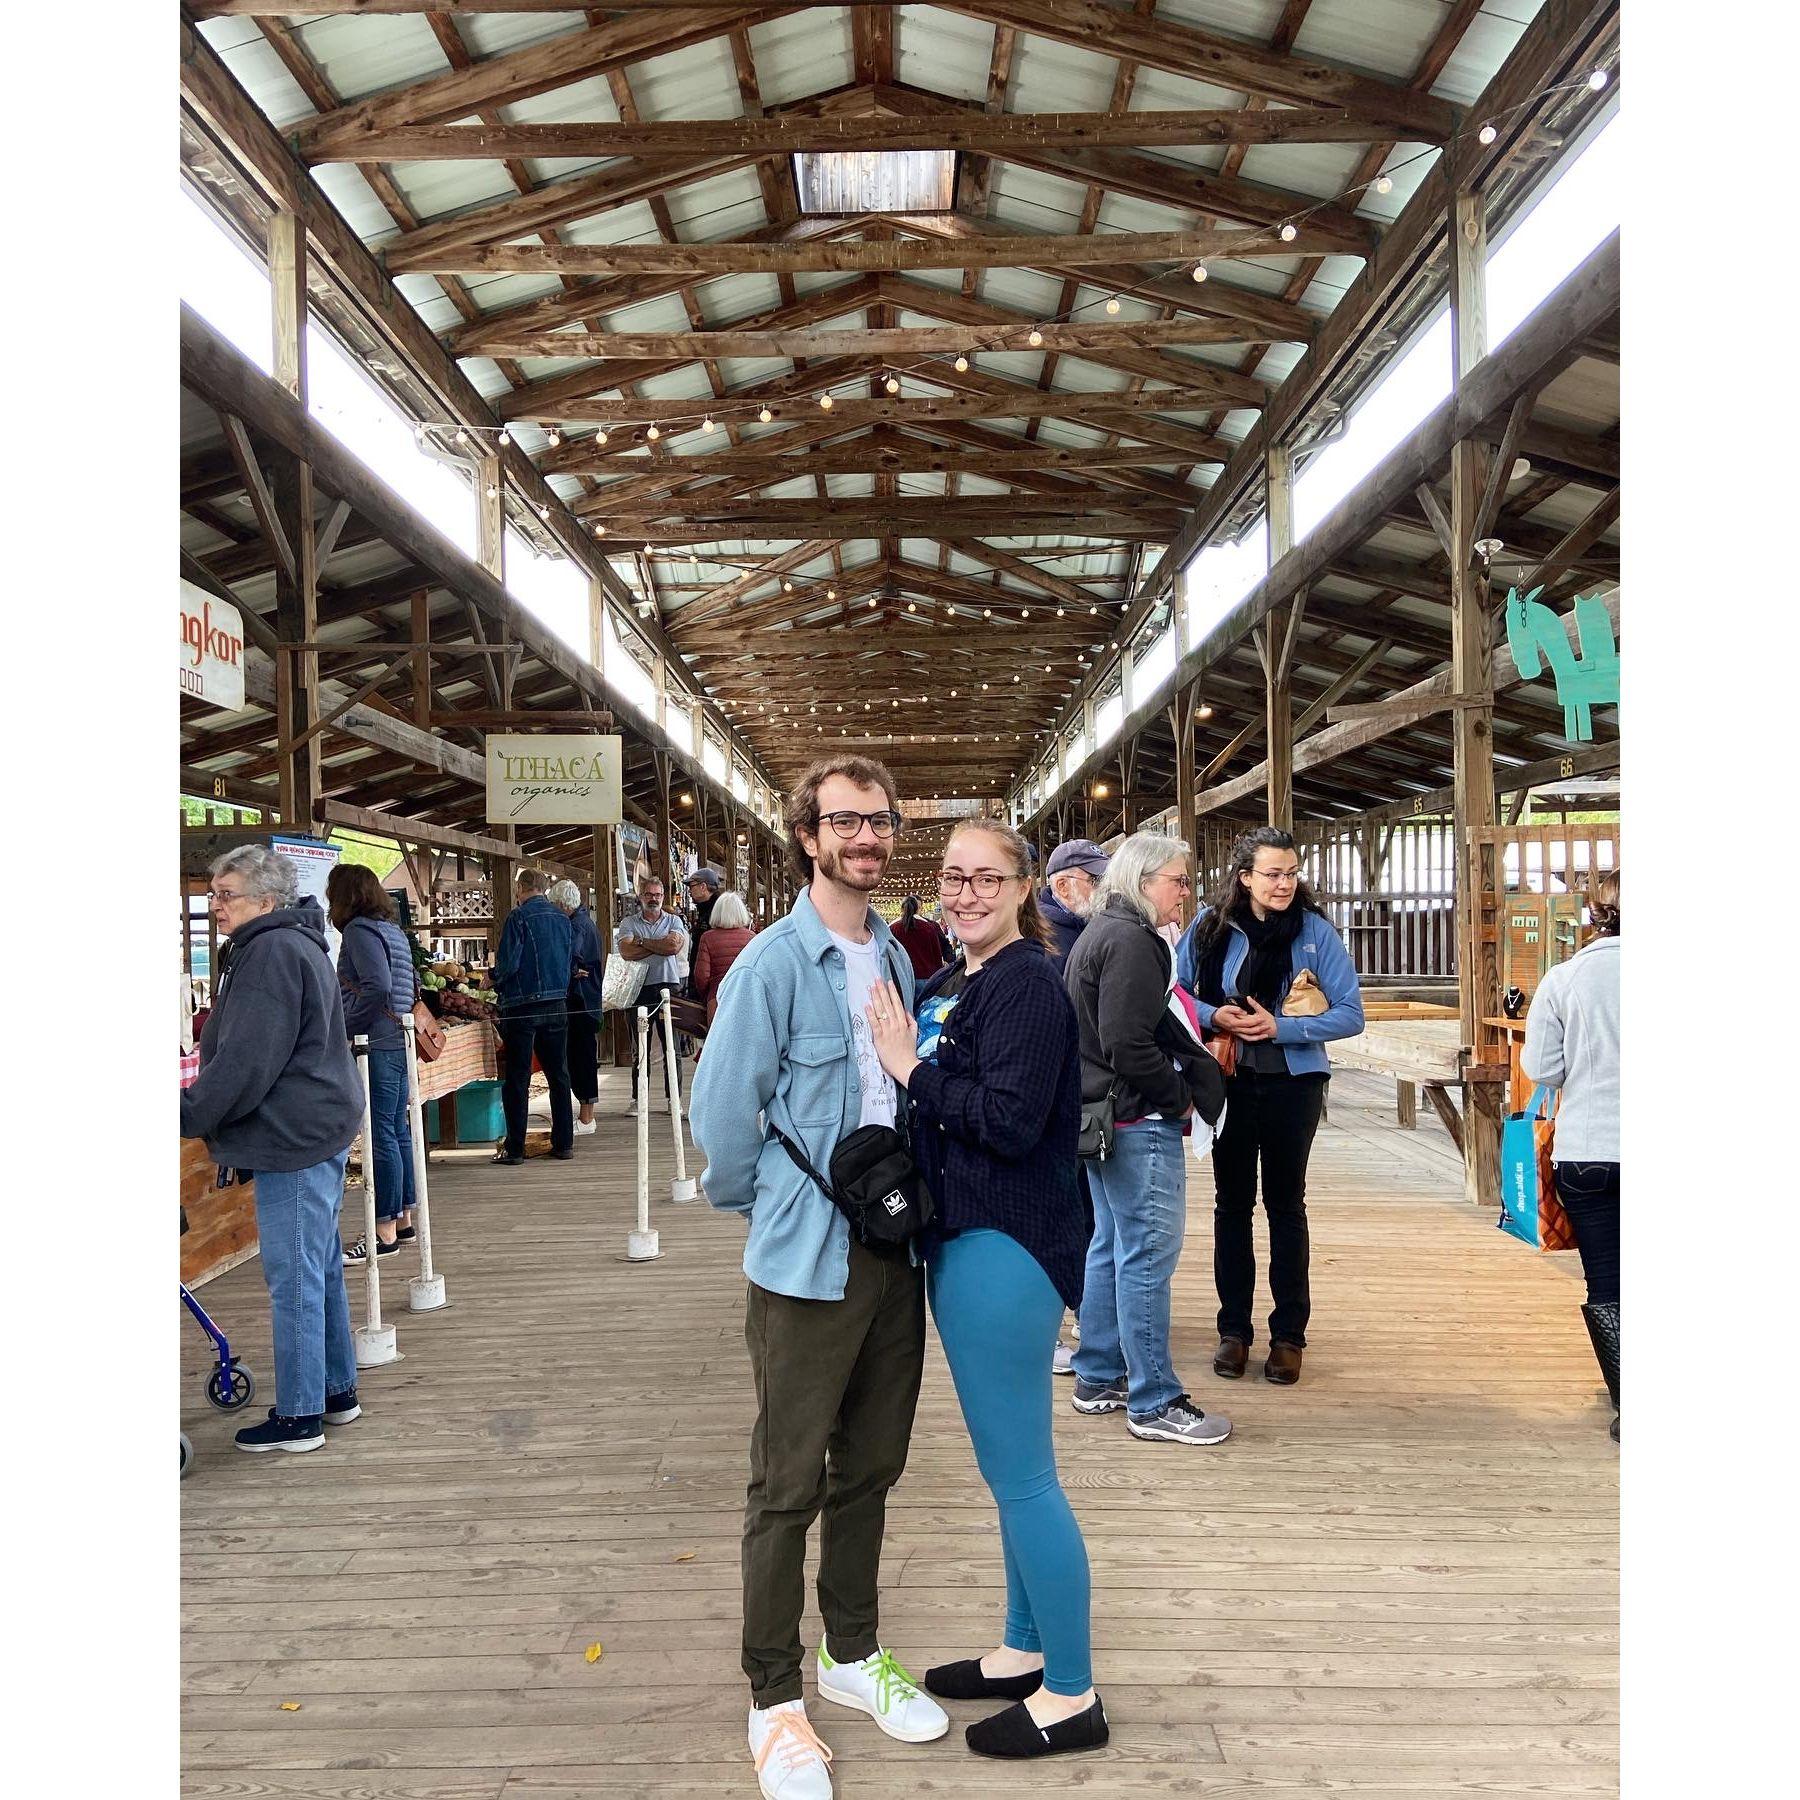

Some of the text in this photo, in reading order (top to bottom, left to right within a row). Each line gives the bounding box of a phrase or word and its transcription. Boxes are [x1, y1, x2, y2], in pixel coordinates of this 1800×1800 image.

[502, 754, 605, 780] ITHACA
[1560, 757, 1574, 777] 66
[214, 777, 226, 797] 81
[510, 783, 591, 817] organics
[1414, 797, 1423, 813] 65
